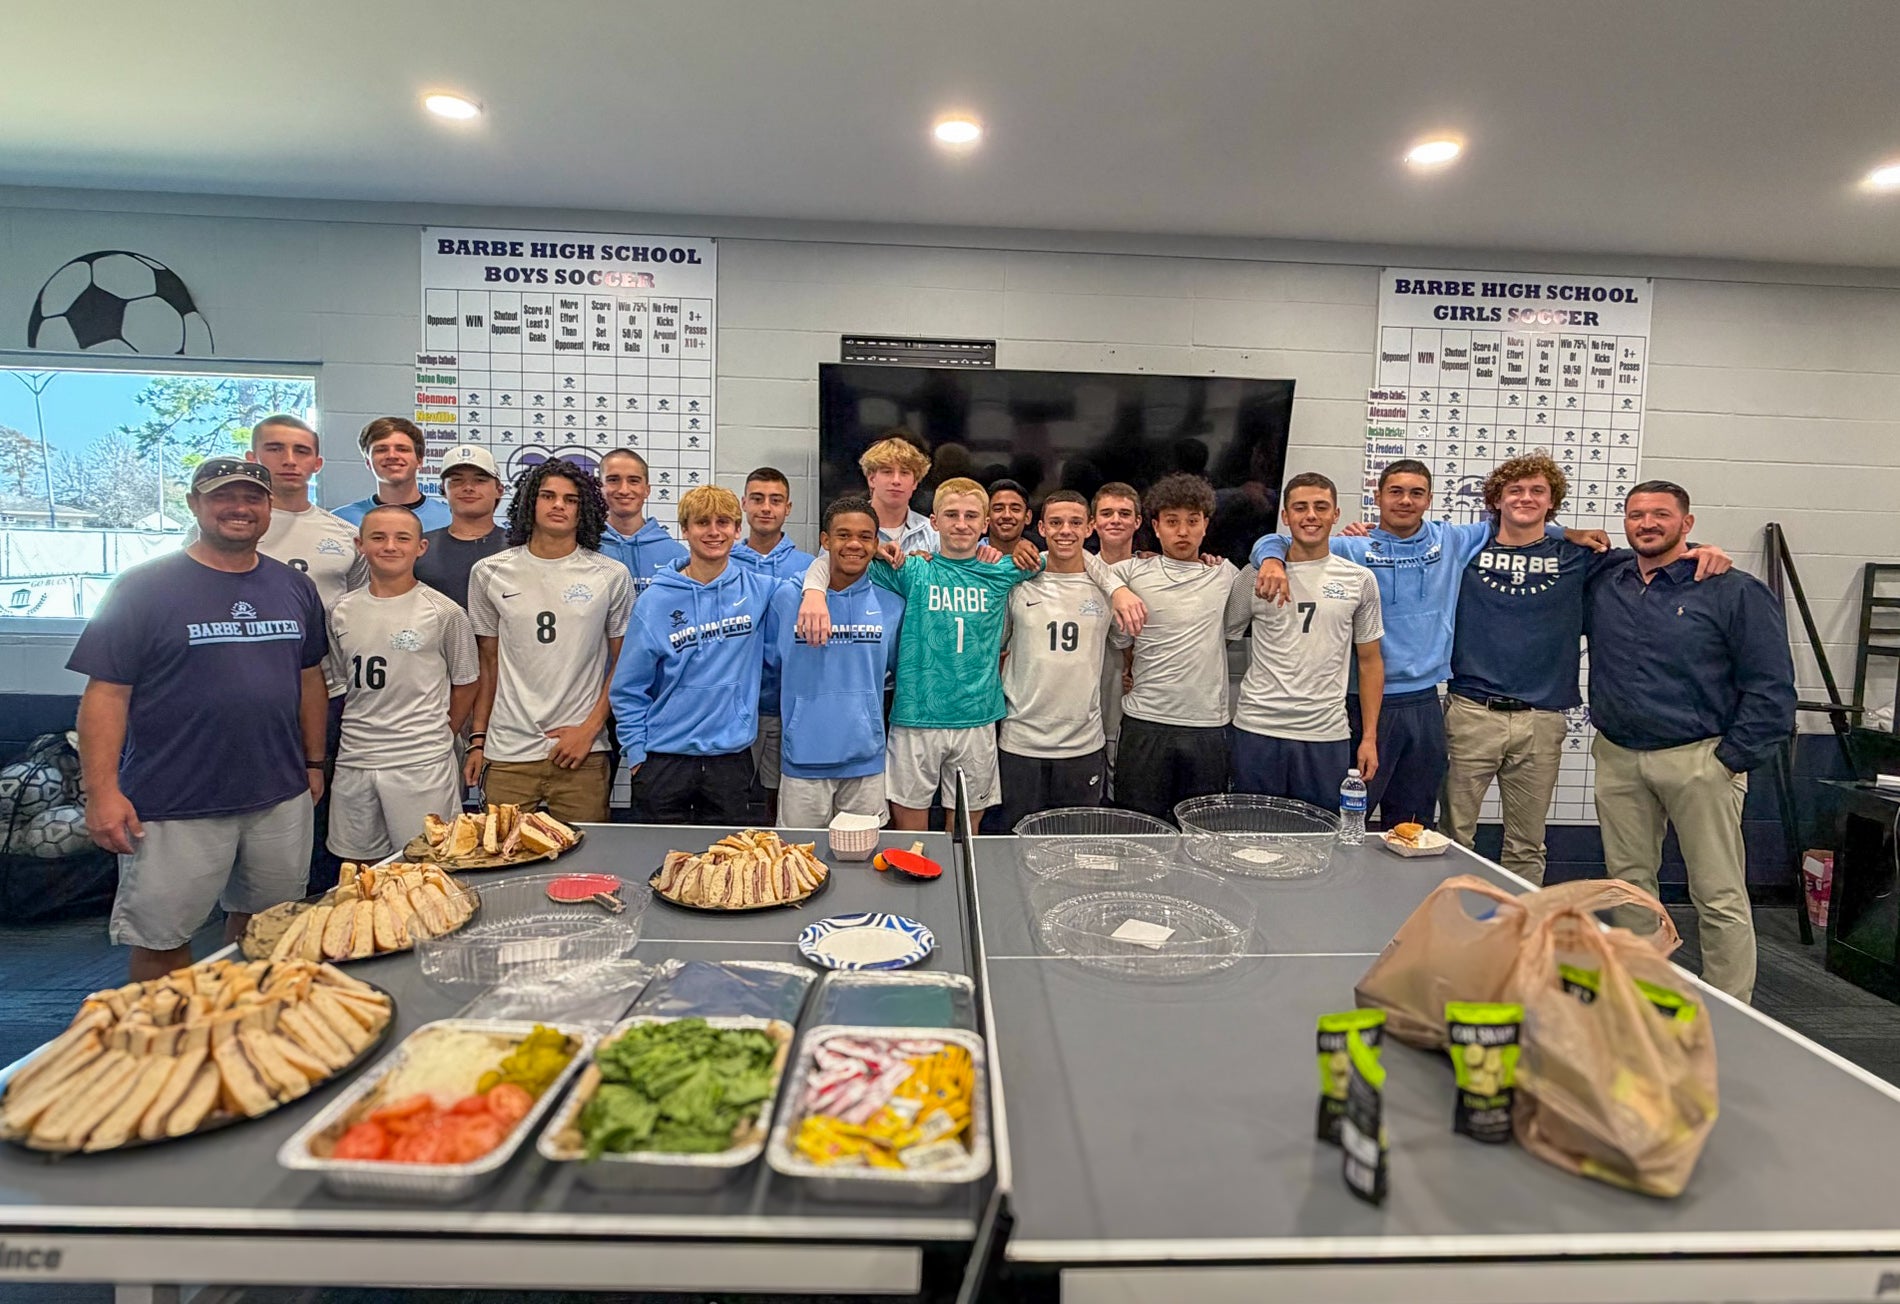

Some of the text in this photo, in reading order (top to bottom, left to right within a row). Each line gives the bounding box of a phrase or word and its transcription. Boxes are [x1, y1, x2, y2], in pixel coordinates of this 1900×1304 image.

[438, 239, 702, 264] BARBE HIGH SCHOOL
[485, 267, 655, 288] BOYS SOCCER
[1396, 279, 1638, 303] BARBE HIGH SCHOOL
[560, 299, 578, 310] More
[592, 301, 611, 311] Score
[619, 302, 647, 312] Win 75%
[653, 303, 678, 313] No Free
[524, 305, 552, 315] Score At
[428, 315, 456, 326] Opponent
[494, 311, 517, 321] Shutout
[560, 314, 578, 323] Effort
[597, 315, 605, 324] On
[629, 316, 636, 325] Of
[1434, 305, 1599, 326] GIRLS SOCCER
[466, 315, 483, 327] WIN
[526, 318, 549, 328] Least 3
[657, 317, 674, 326] Kicks
[492, 324, 520, 335] Opponent
[562, 327, 577, 336] Than
[596, 328, 606, 337] Set
[623, 329, 642, 339] 50/50
[685, 325, 707, 335] Passes
[529, 332, 546, 342] Goals
[654, 330, 676, 340] Around
[555, 340, 584, 351] Opponent
[593, 341, 610, 351] Piece
[1473, 342, 1491, 351] Score
[1507, 337, 1524, 346] More
[1537, 339, 1554, 348] Score
[1561, 339, 1586, 349] Win 75%
[1592, 341, 1614, 350] No Free
[625, 342, 640, 352] Balls
[1382, 352, 1409, 362] Opponent
[1418, 352, 1434, 363] WIN
[1445, 348, 1467, 357] Shutout
[1507, 350, 1524, 359] Effort
[1475, 355, 1490, 364] Least
[1595, 354, 1610, 363] Kicks
[1442, 361, 1468, 371] Opponent
[1508, 363, 1521, 372] Than
[1539, 364, 1549, 373] Set
[1563, 365, 1581, 374] 50/50
[1591, 366, 1612, 376] Around
[1620, 362, 1640, 371] Passes
[1477, 368, 1493, 377] Goals
[417, 373, 456, 385] Baton Rouge
[1501, 375, 1527, 386] Opponent
[1535, 377, 1551, 386] Piece
[417, 393, 456, 405] Glenmora
[416, 411, 456, 422] Neville
[1370, 407, 1406, 418] Alexandria
[1376, 444, 1404, 454] Frederick
[1479, 552, 1559, 573] BARBE
[1511, 572, 1526, 585] B
[929, 585, 989, 612] BARBE
[1298, 602, 1316, 633] 7
[187, 620, 299, 639] BARBE UNITED
[536, 611, 556, 644] 8
[794, 624, 882, 639] ANEERS
[954, 617, 964, 653] 1
[1047, 621, 1079, 651] 19
[352, 655, 387, 690] 16
